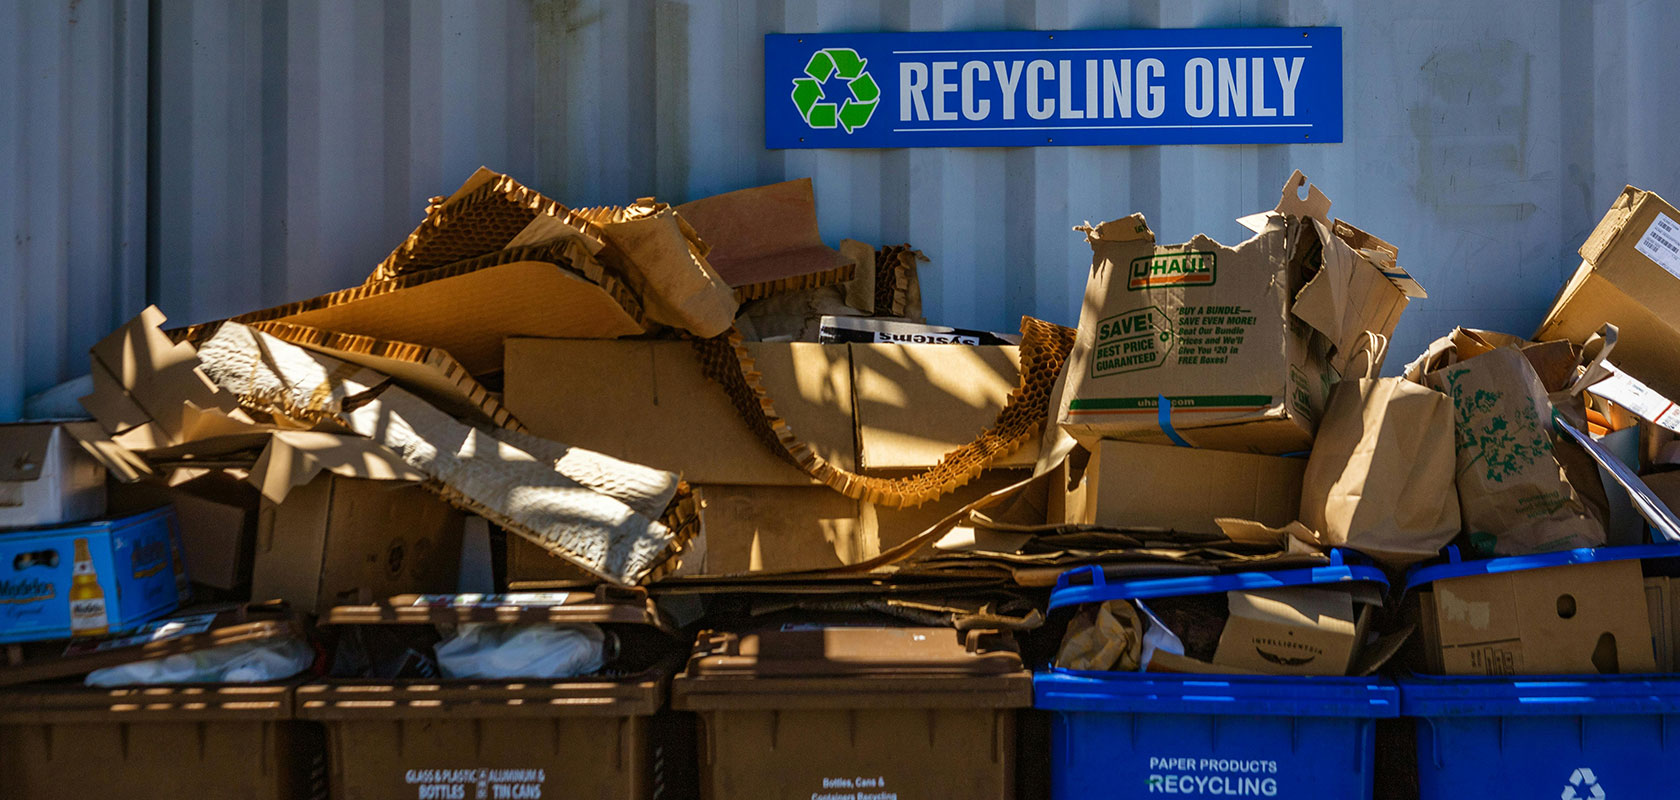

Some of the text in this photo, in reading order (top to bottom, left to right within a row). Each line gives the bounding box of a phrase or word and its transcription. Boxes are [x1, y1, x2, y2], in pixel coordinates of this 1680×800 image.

[899, 56, 1306, 122] RECYCLING ONLY
[1133, 256, 1210, 278] U-HAUL
[1197, 306, 1204, 315] A
[1099, 313, 1154, 341] SAVE!
[1178, 316, 1257, 326] SAVE EVEN MORE!
[1178, 326, 1245, 335] Beat Our Bundle
[1178, 335, 1244, 346] Prices and We'll
[1097, 338, 1154, 360] BEST PRICE
[1178, 346, 1195, 355] Give
[1198, 346, 1212, 355] You
[1229, 345, 1239, 354] in
[1178, 355, 1229, 366] FREE Boxes!
[1137, 397, 1195, 408] uhacom
[1149, 756, 1278, 774] PAPER PRODUCTS
[405, 768, 477, 784] GLASS & PLASTIC
[487, 768, 546, 783] ALUMINUM &
[822, 775, 885, 790] Bottles, Cans &
[418, 784, 466, 800] BOTTLES
[492, 783, 542, 800] TIN CANS
[1148, 773, 1278, 797] RECYCLING
